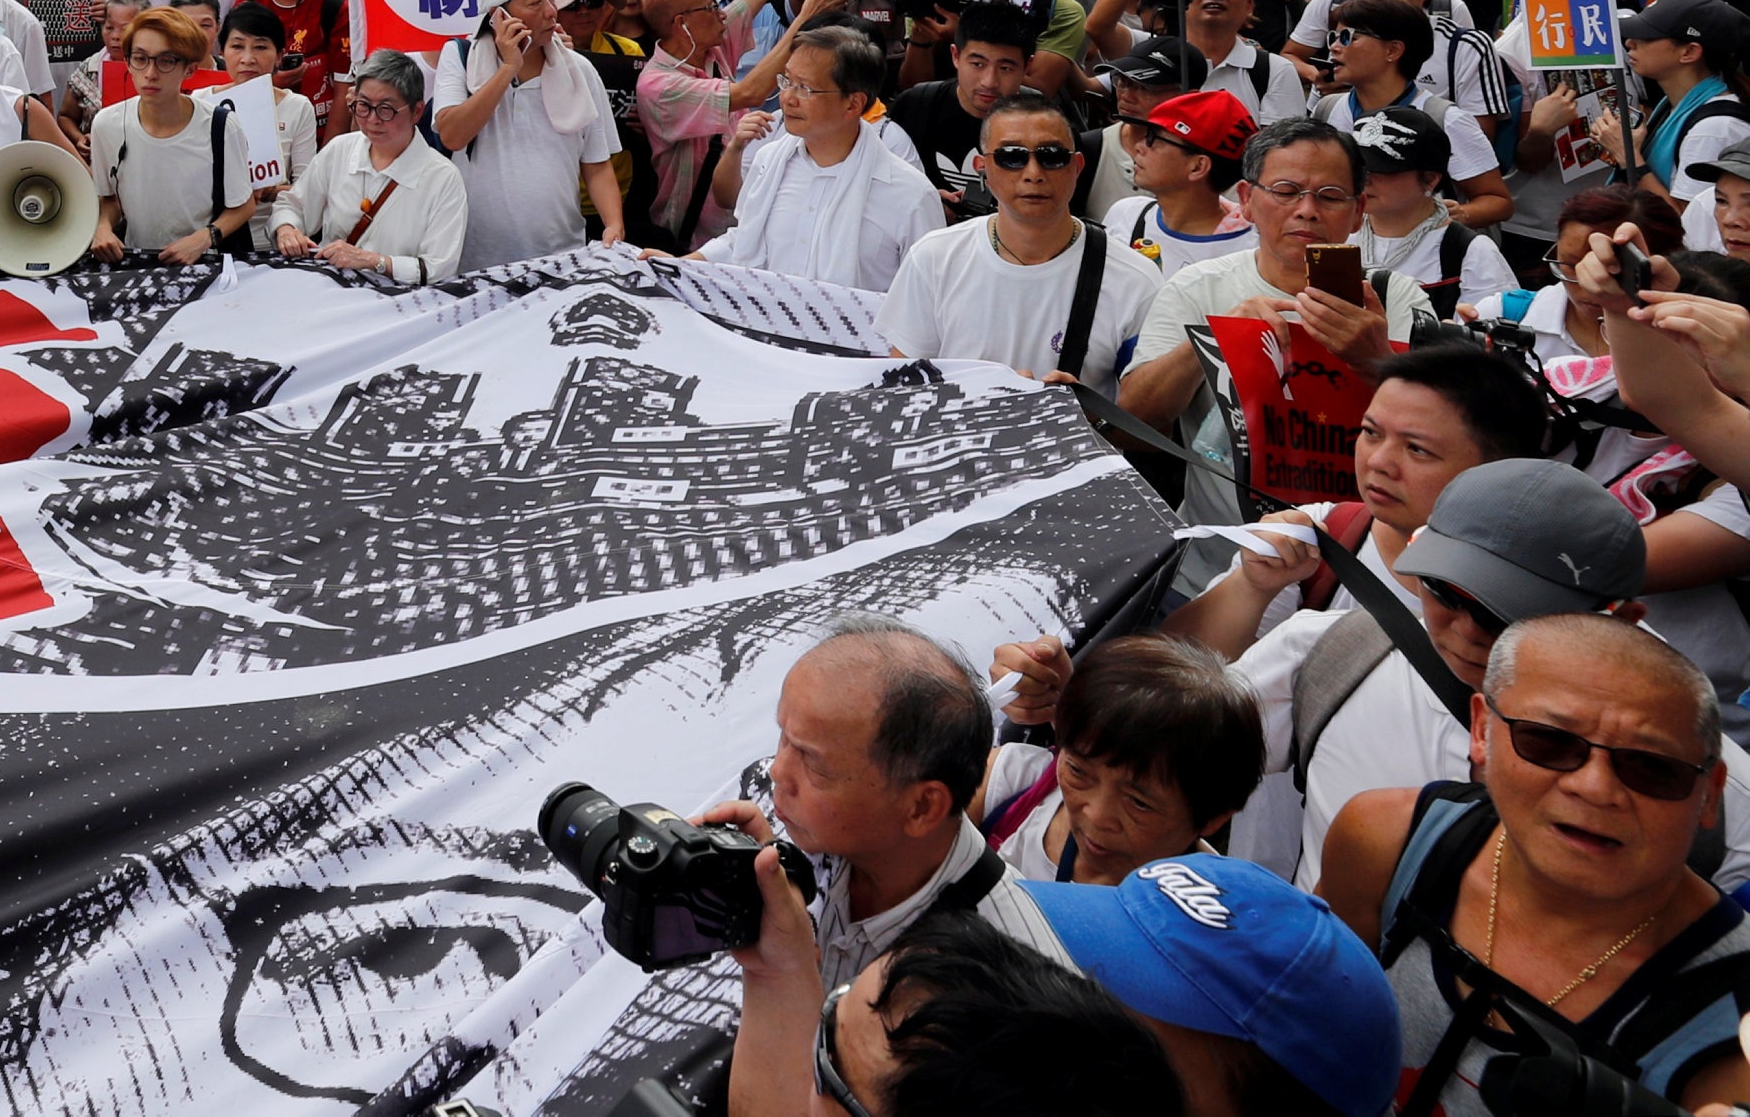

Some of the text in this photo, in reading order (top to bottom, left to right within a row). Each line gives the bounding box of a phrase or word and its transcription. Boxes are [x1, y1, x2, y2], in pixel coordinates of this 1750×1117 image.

[64, 0, 92, 32] 送
[862, 10, 891, 22] MARVEL
[1263, 404, 1286, 447] No
